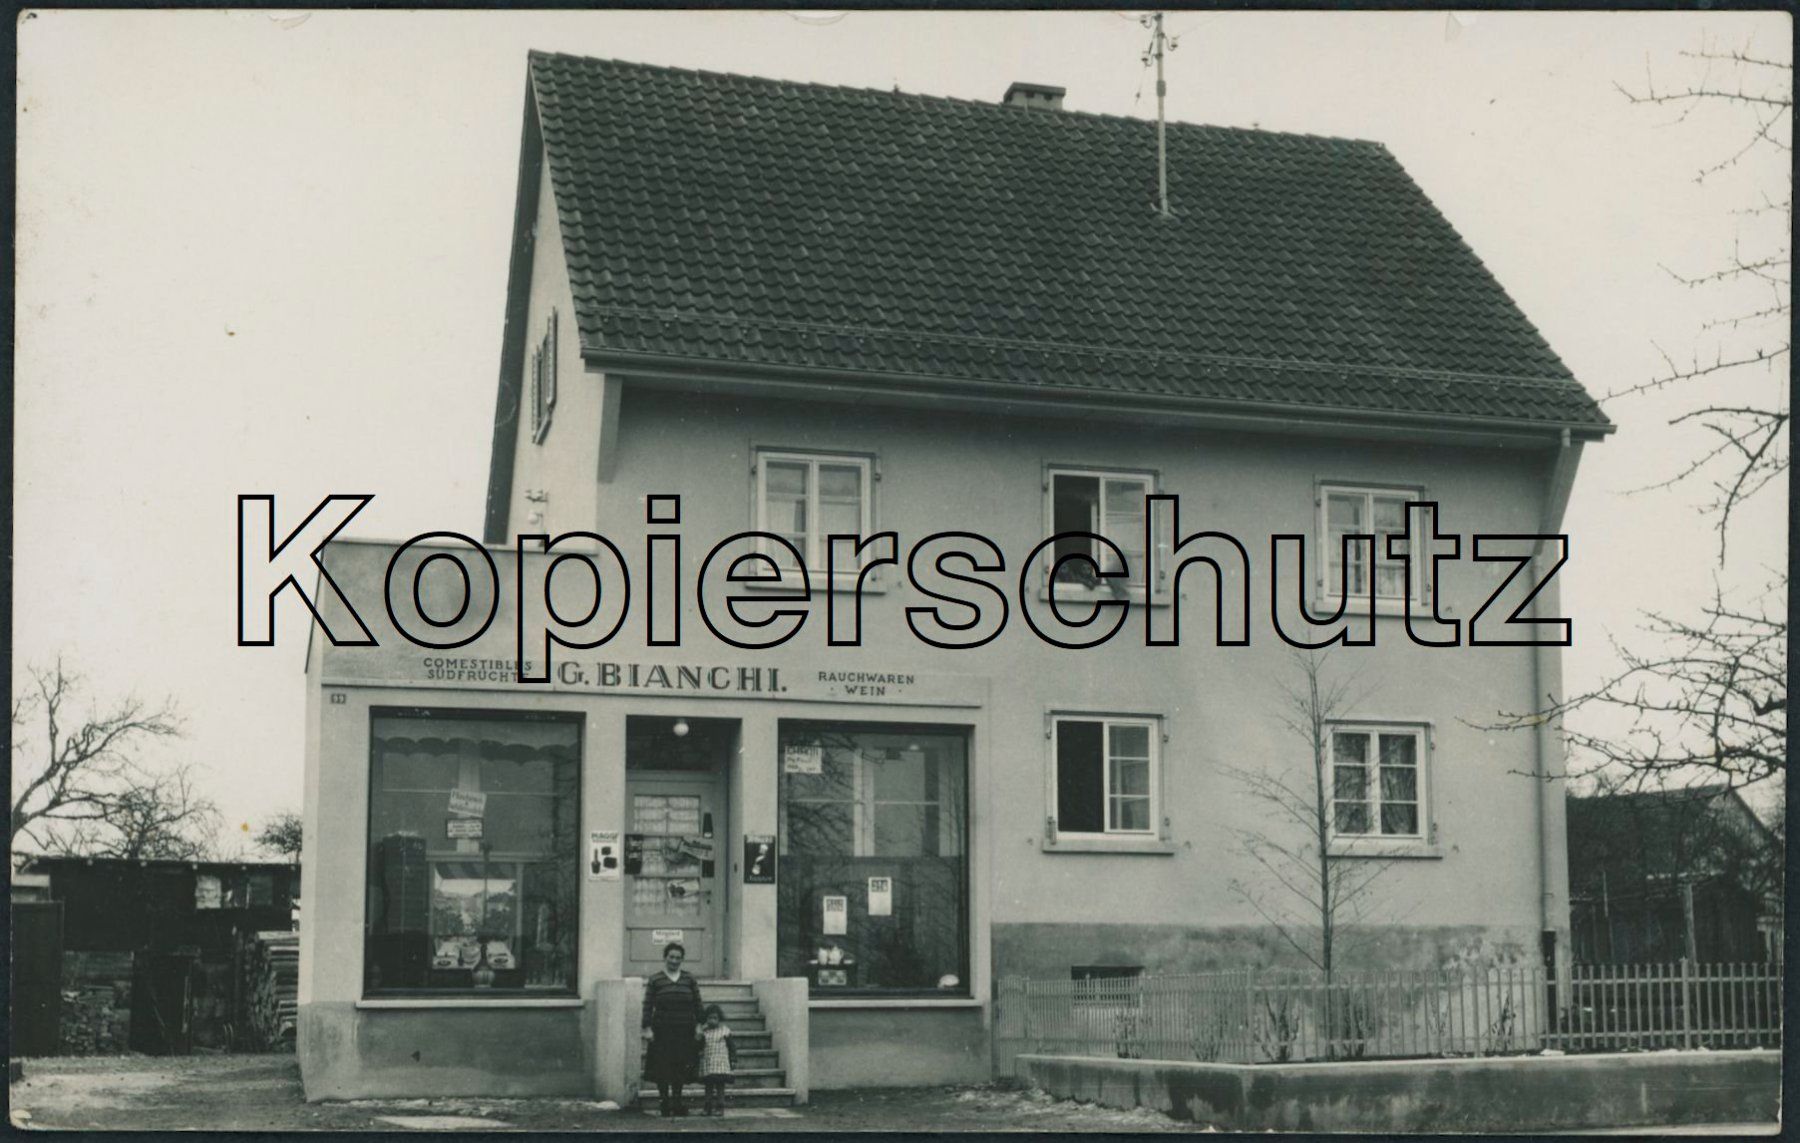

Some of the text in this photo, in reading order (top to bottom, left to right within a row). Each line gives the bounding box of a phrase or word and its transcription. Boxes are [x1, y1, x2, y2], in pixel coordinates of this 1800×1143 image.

[428, 667, 529, 682] SÜDFRÜCHT
[817, 671, 915, 685] RAUCHWAREN
[844, 685, 886, 697] WEIN
